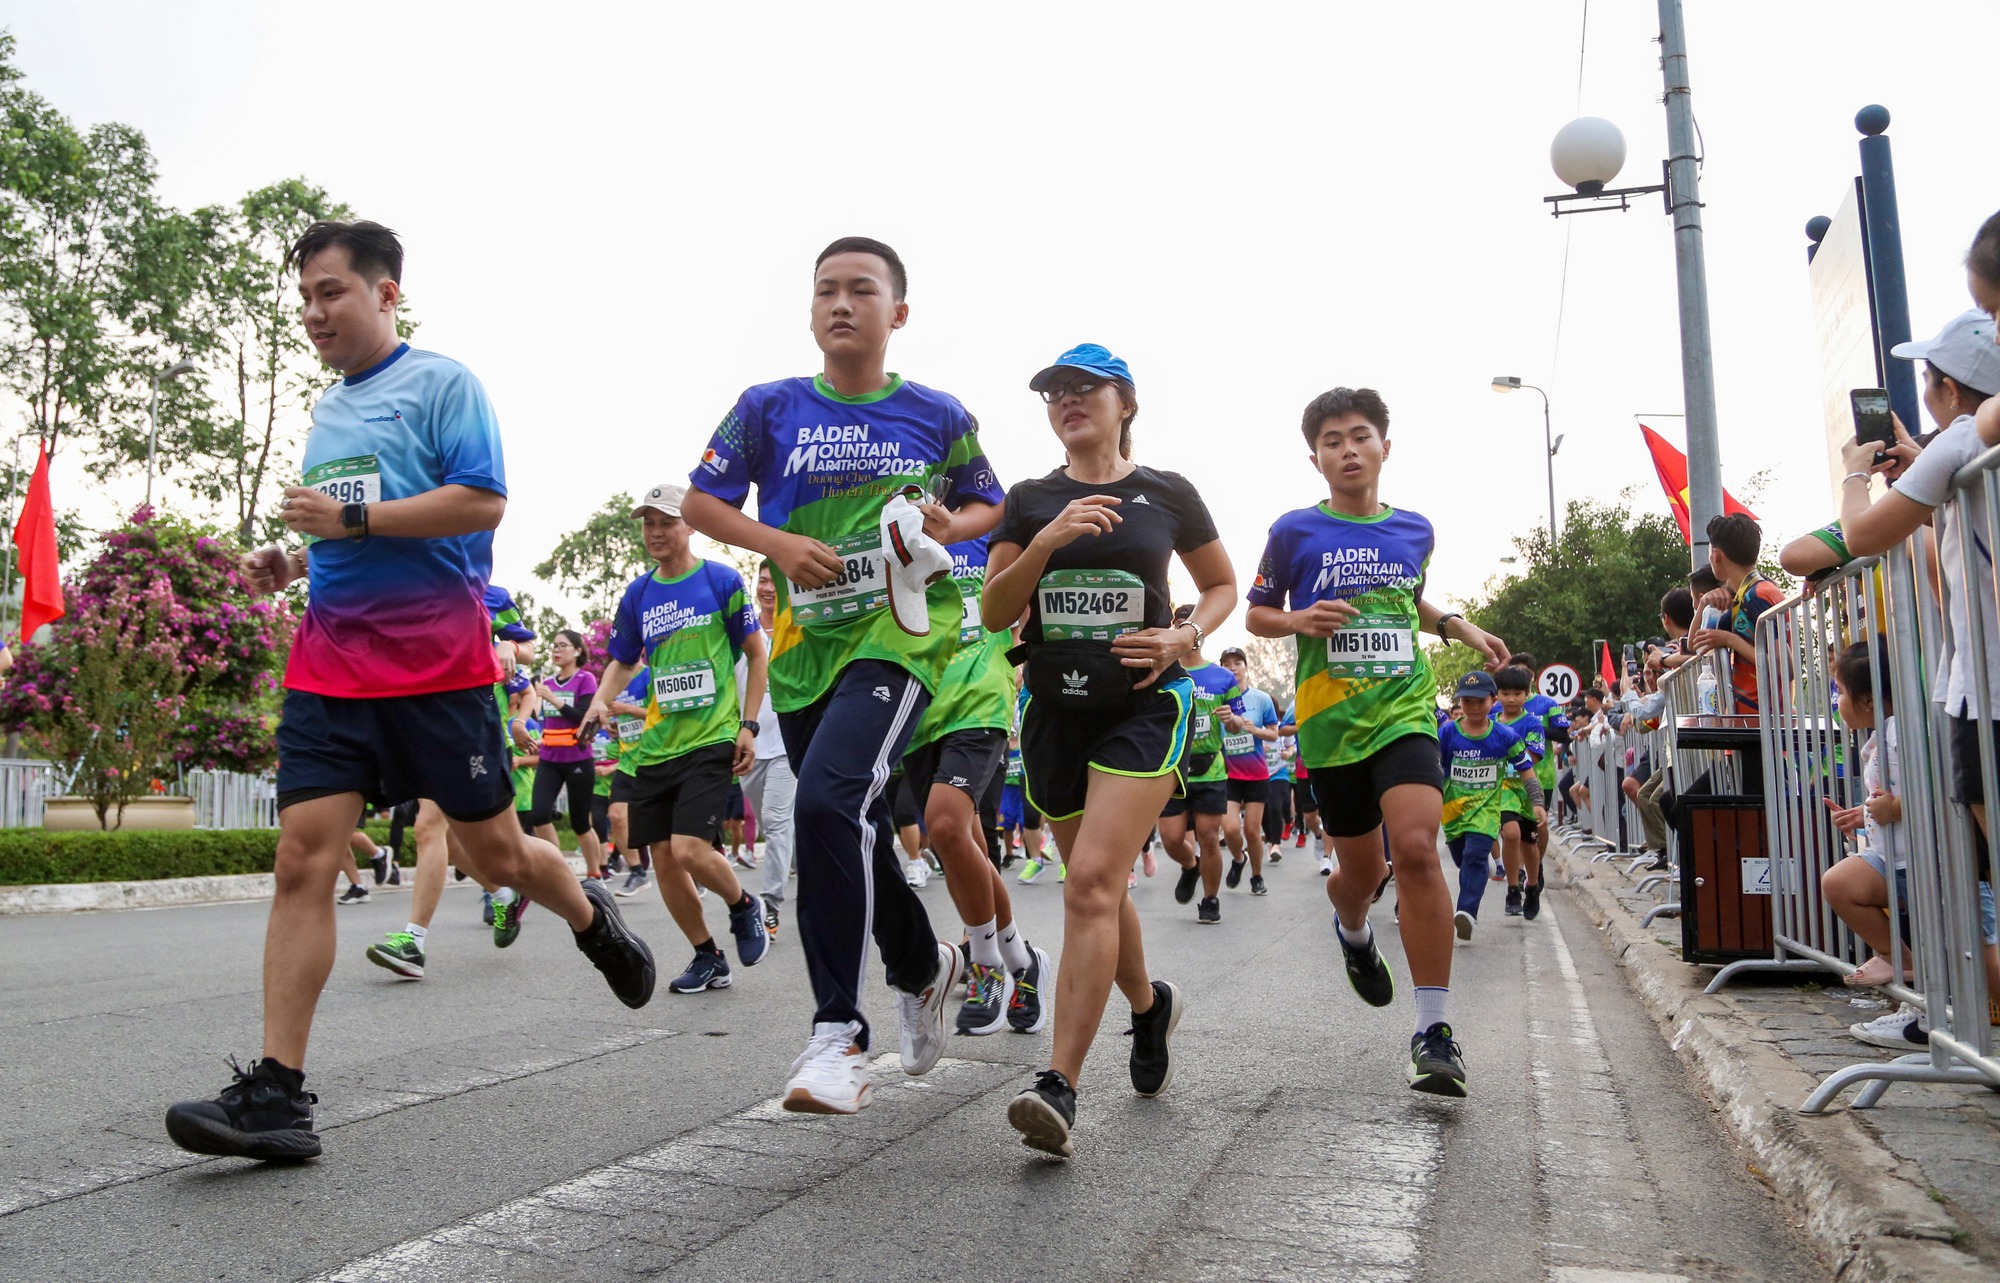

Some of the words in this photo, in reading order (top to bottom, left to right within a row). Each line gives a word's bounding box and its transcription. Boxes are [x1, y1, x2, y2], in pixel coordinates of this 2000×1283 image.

[797, 424, 869, 445] BADEN
[877, 458, 926, 477] 2023
[1322, 547, 1379, 567] BADEN
[643, 600, 678, 622] BADEN
[1044, 591, 1129, 614] M52462
[682, 614, 712, 629] 2023
[1331, 632, 1399, 653] M51801
[657, 673, 703, 695] M50607
[1062, 687, 1088, 696] adidas
[1546, 672, 1572, 697] 30
[1453, 767, 1490, 778] M52127
